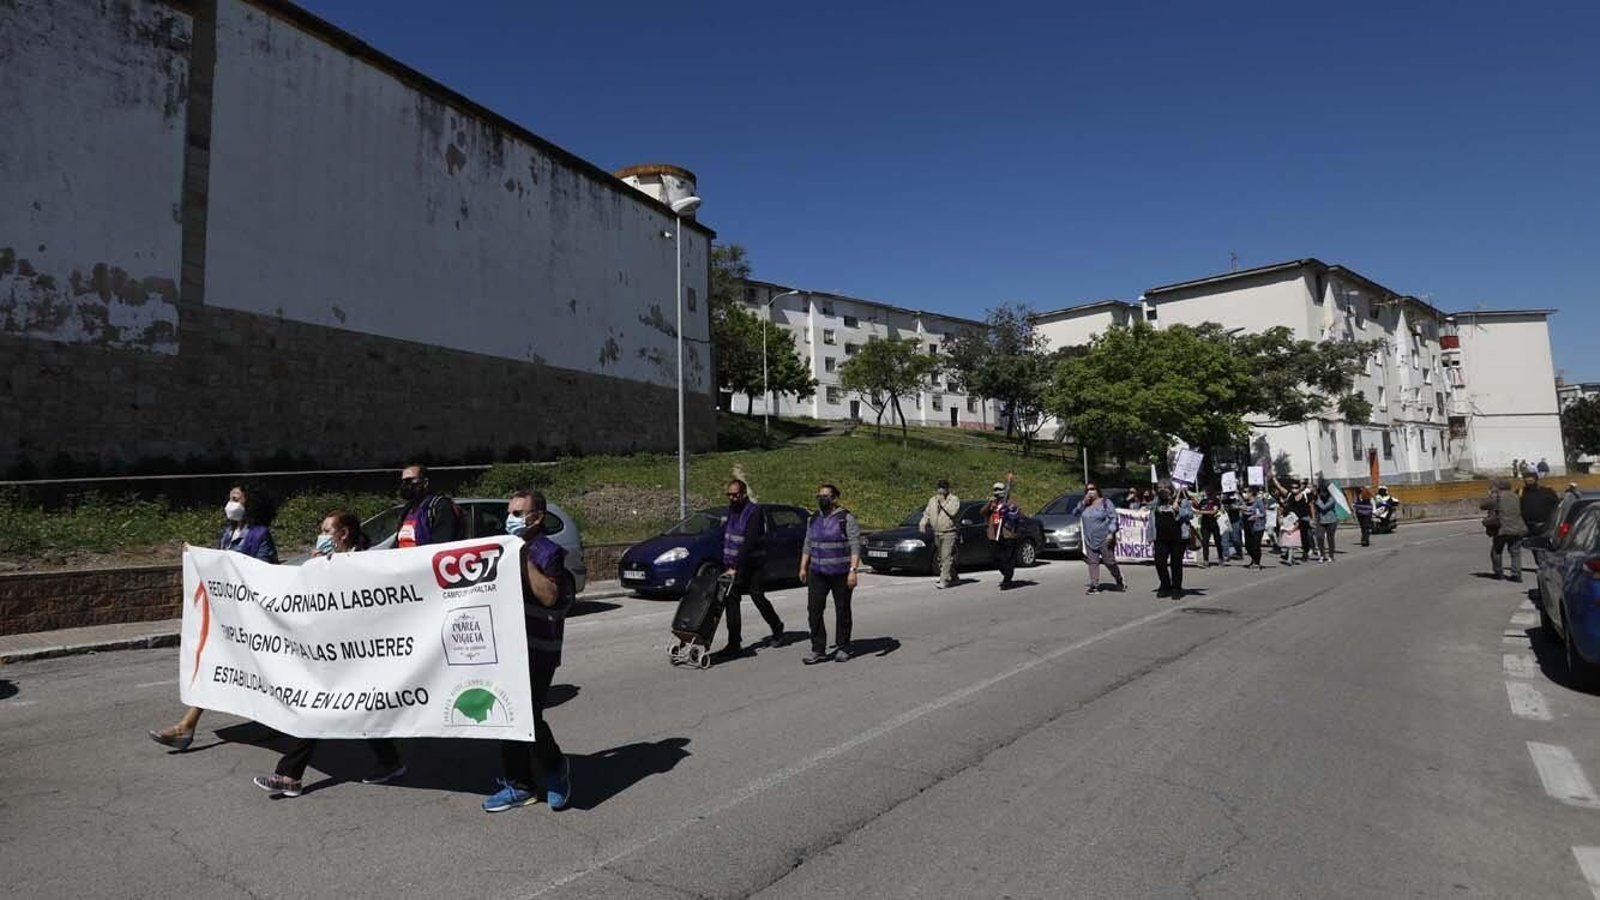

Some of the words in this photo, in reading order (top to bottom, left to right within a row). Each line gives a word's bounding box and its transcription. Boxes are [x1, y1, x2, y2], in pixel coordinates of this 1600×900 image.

[438, 549, 500, 584] CGT
[340, 584, 424, 610] LABORAL
[307, 643, 338, 662] LAS
[340, 636, 415, 660] MUJERES
[310, 692, 335, 710] EN
[332, 692, 355, 711] LO
[354, 686, 429, 712] PÚBLICO
